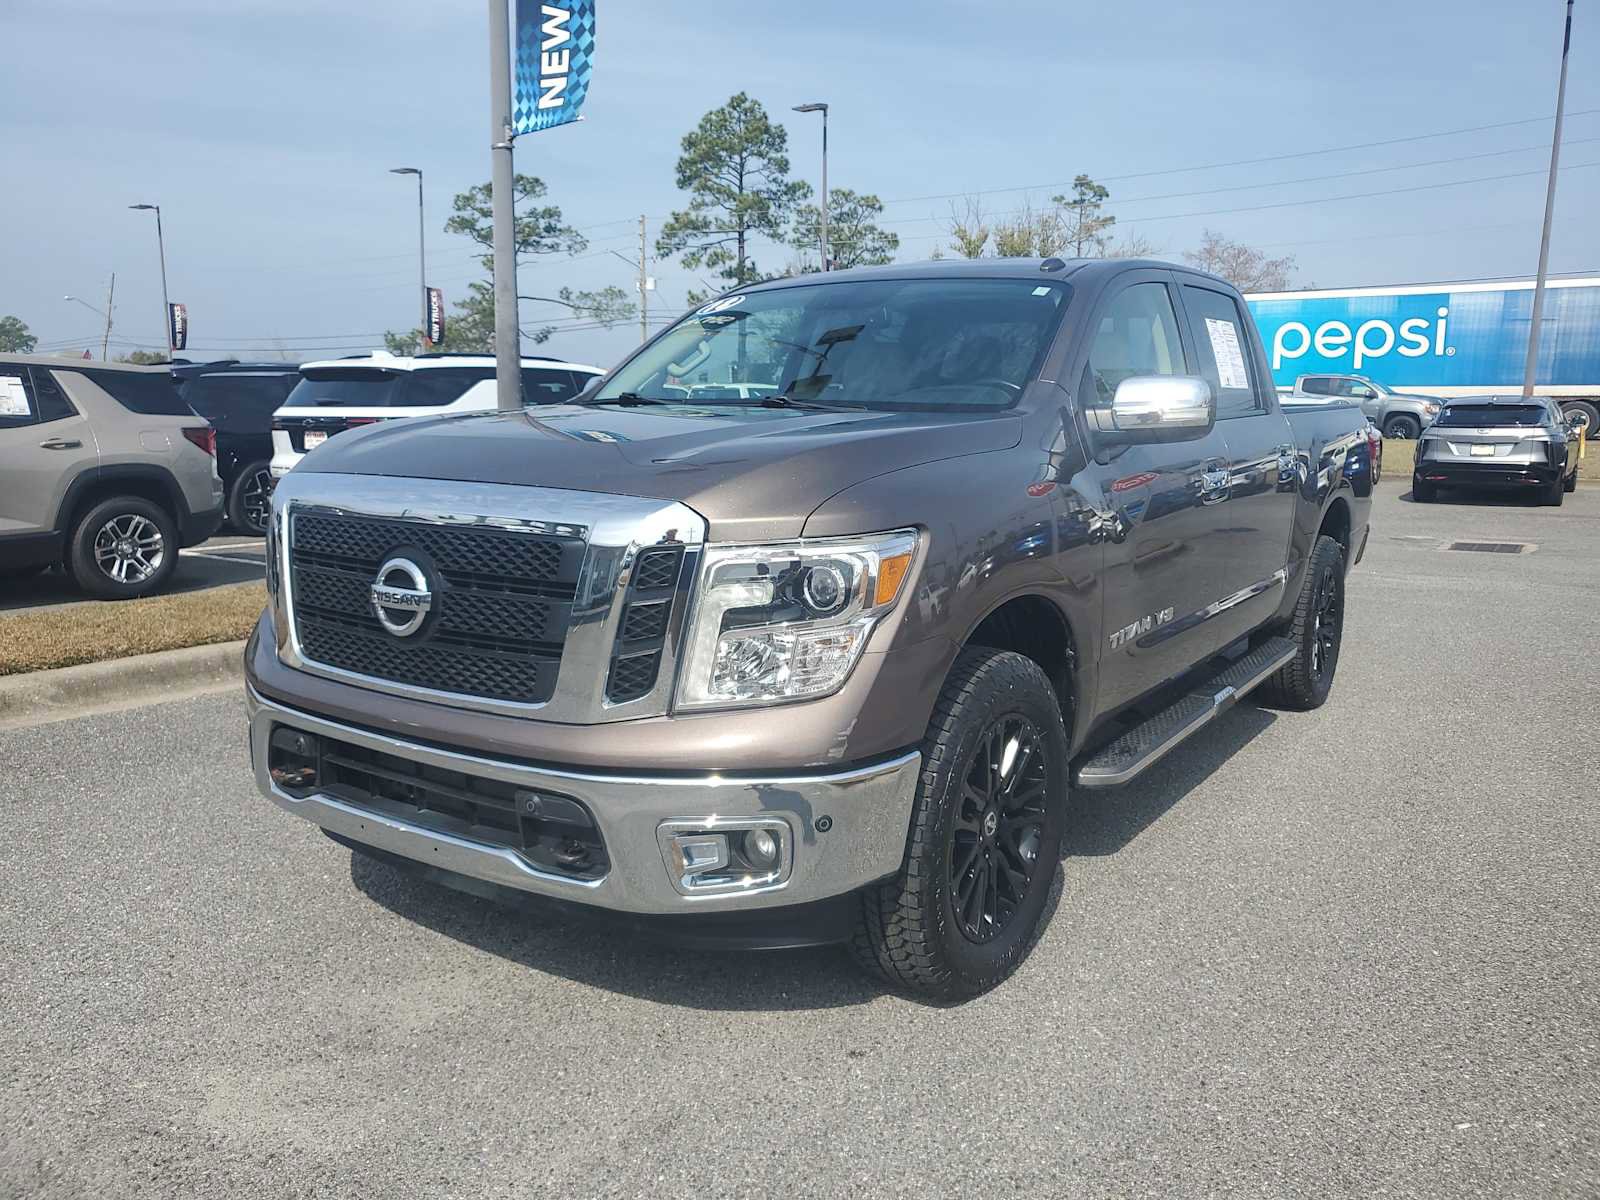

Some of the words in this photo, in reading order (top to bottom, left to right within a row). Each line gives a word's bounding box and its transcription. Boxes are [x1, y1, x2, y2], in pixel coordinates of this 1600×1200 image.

[538, 4, 571, 110] NEW
[431, 290, 439, 322] TRUCKS
[432, 323, 440, 342] NEW
[1272, 307, 1449, 370] pepsi
[372, 588, 422, 607] NISSAN
[1109, 615, 1152, 649] TITAN
